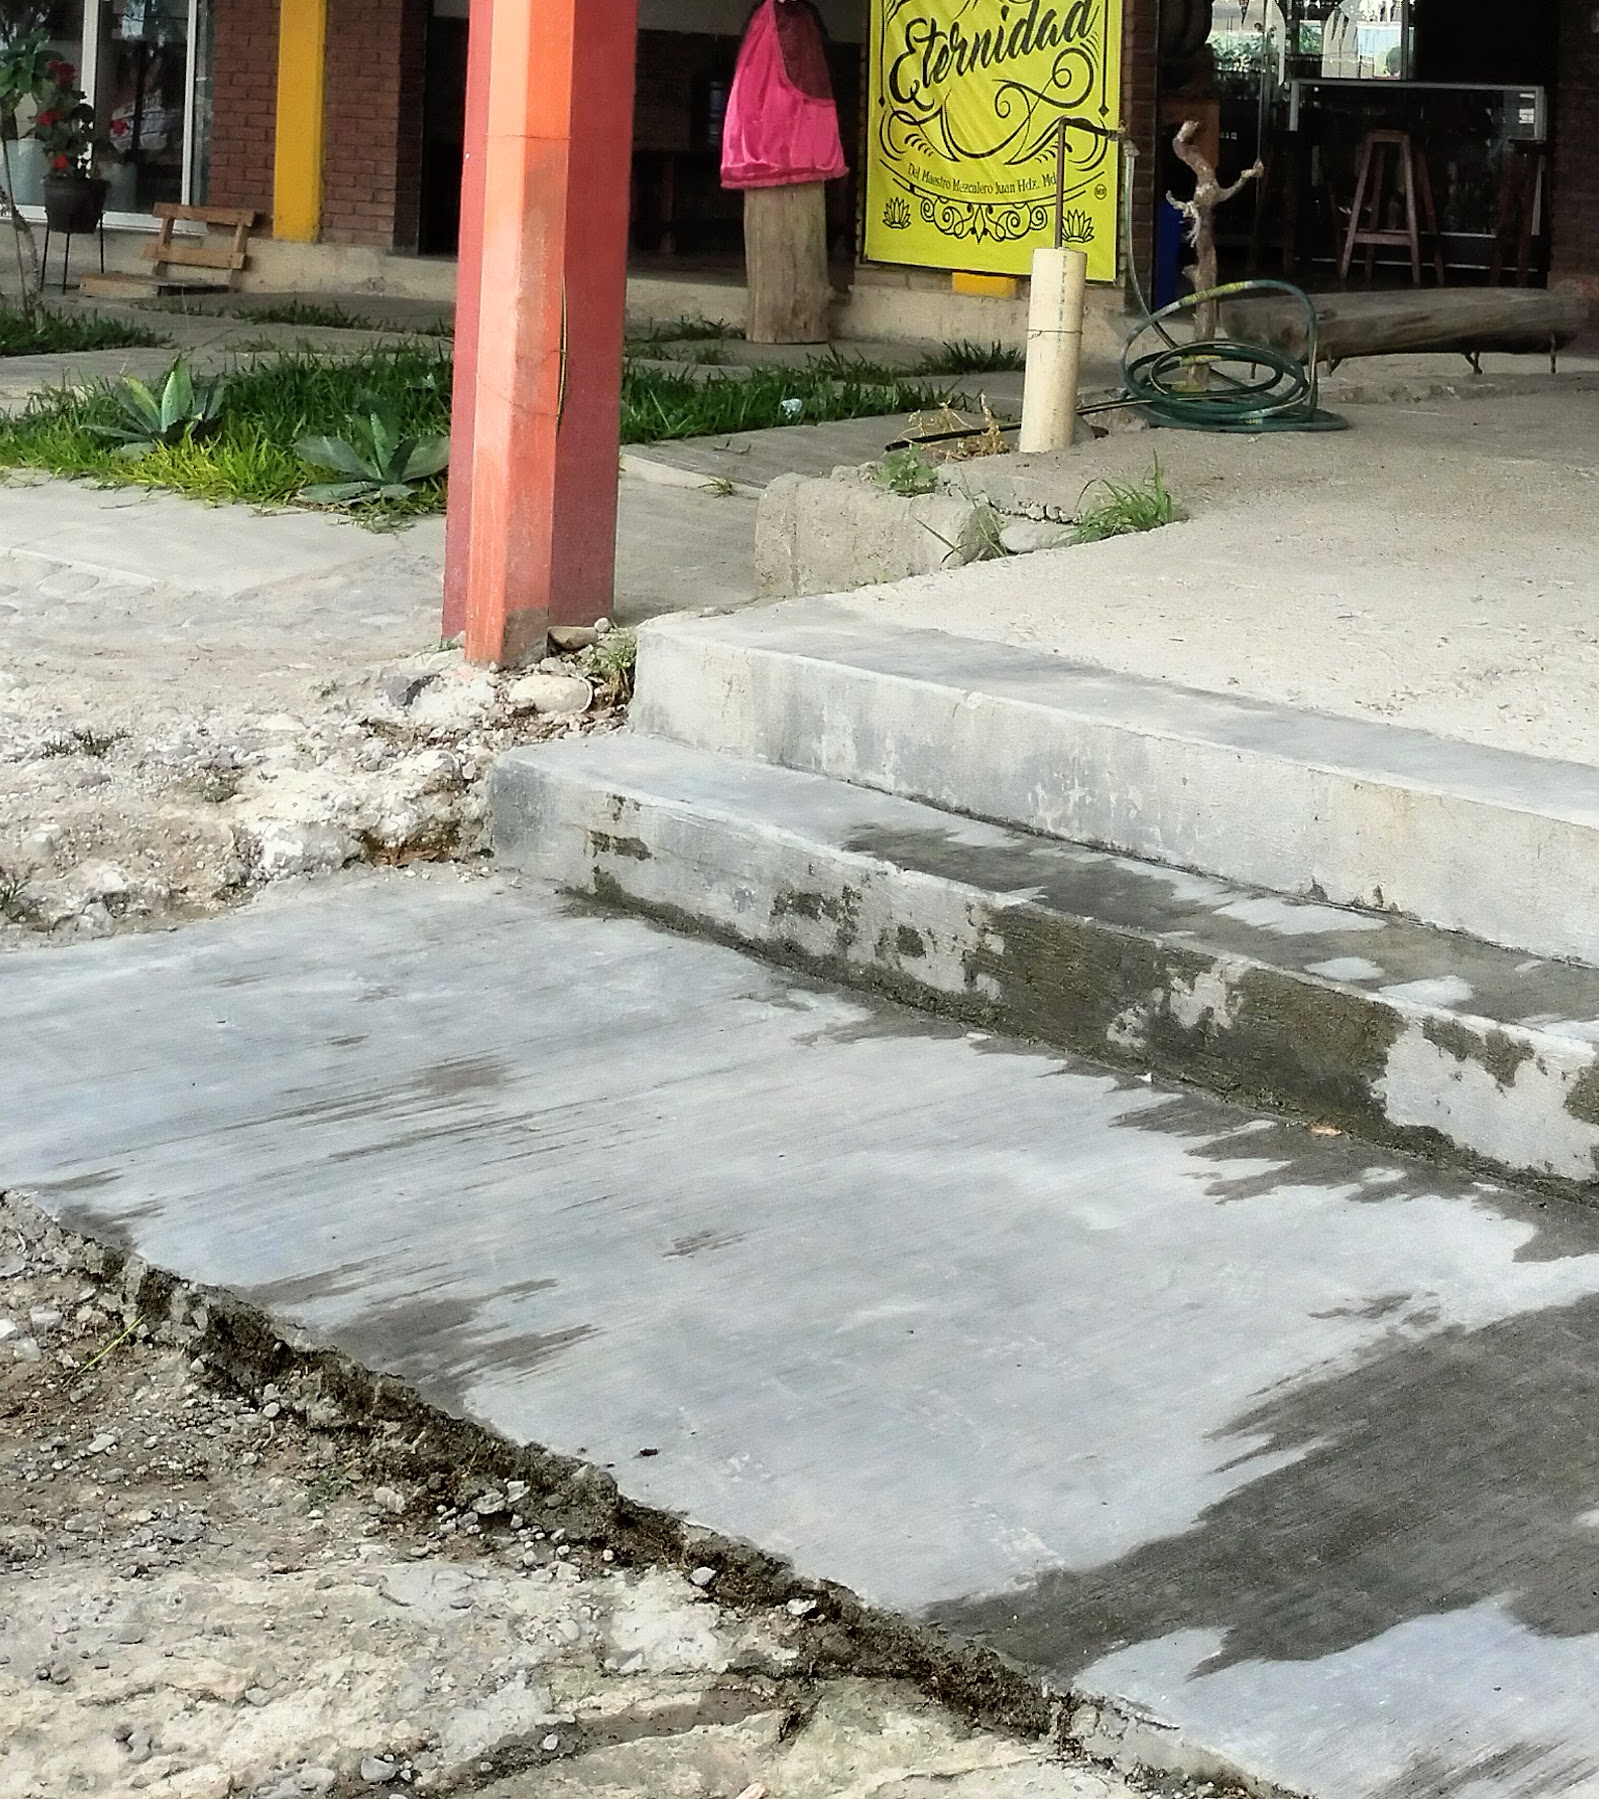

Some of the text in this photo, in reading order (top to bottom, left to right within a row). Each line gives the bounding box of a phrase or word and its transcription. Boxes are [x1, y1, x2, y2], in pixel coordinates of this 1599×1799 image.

[907, 162, 920, 180] Del
[921, 169, 951, 190] Maestro
[952, 178, 994, 195] Mezcalero
[995, 182, 1016, 195] Juan
[1017, 179, 1040, 192] Hdz.
